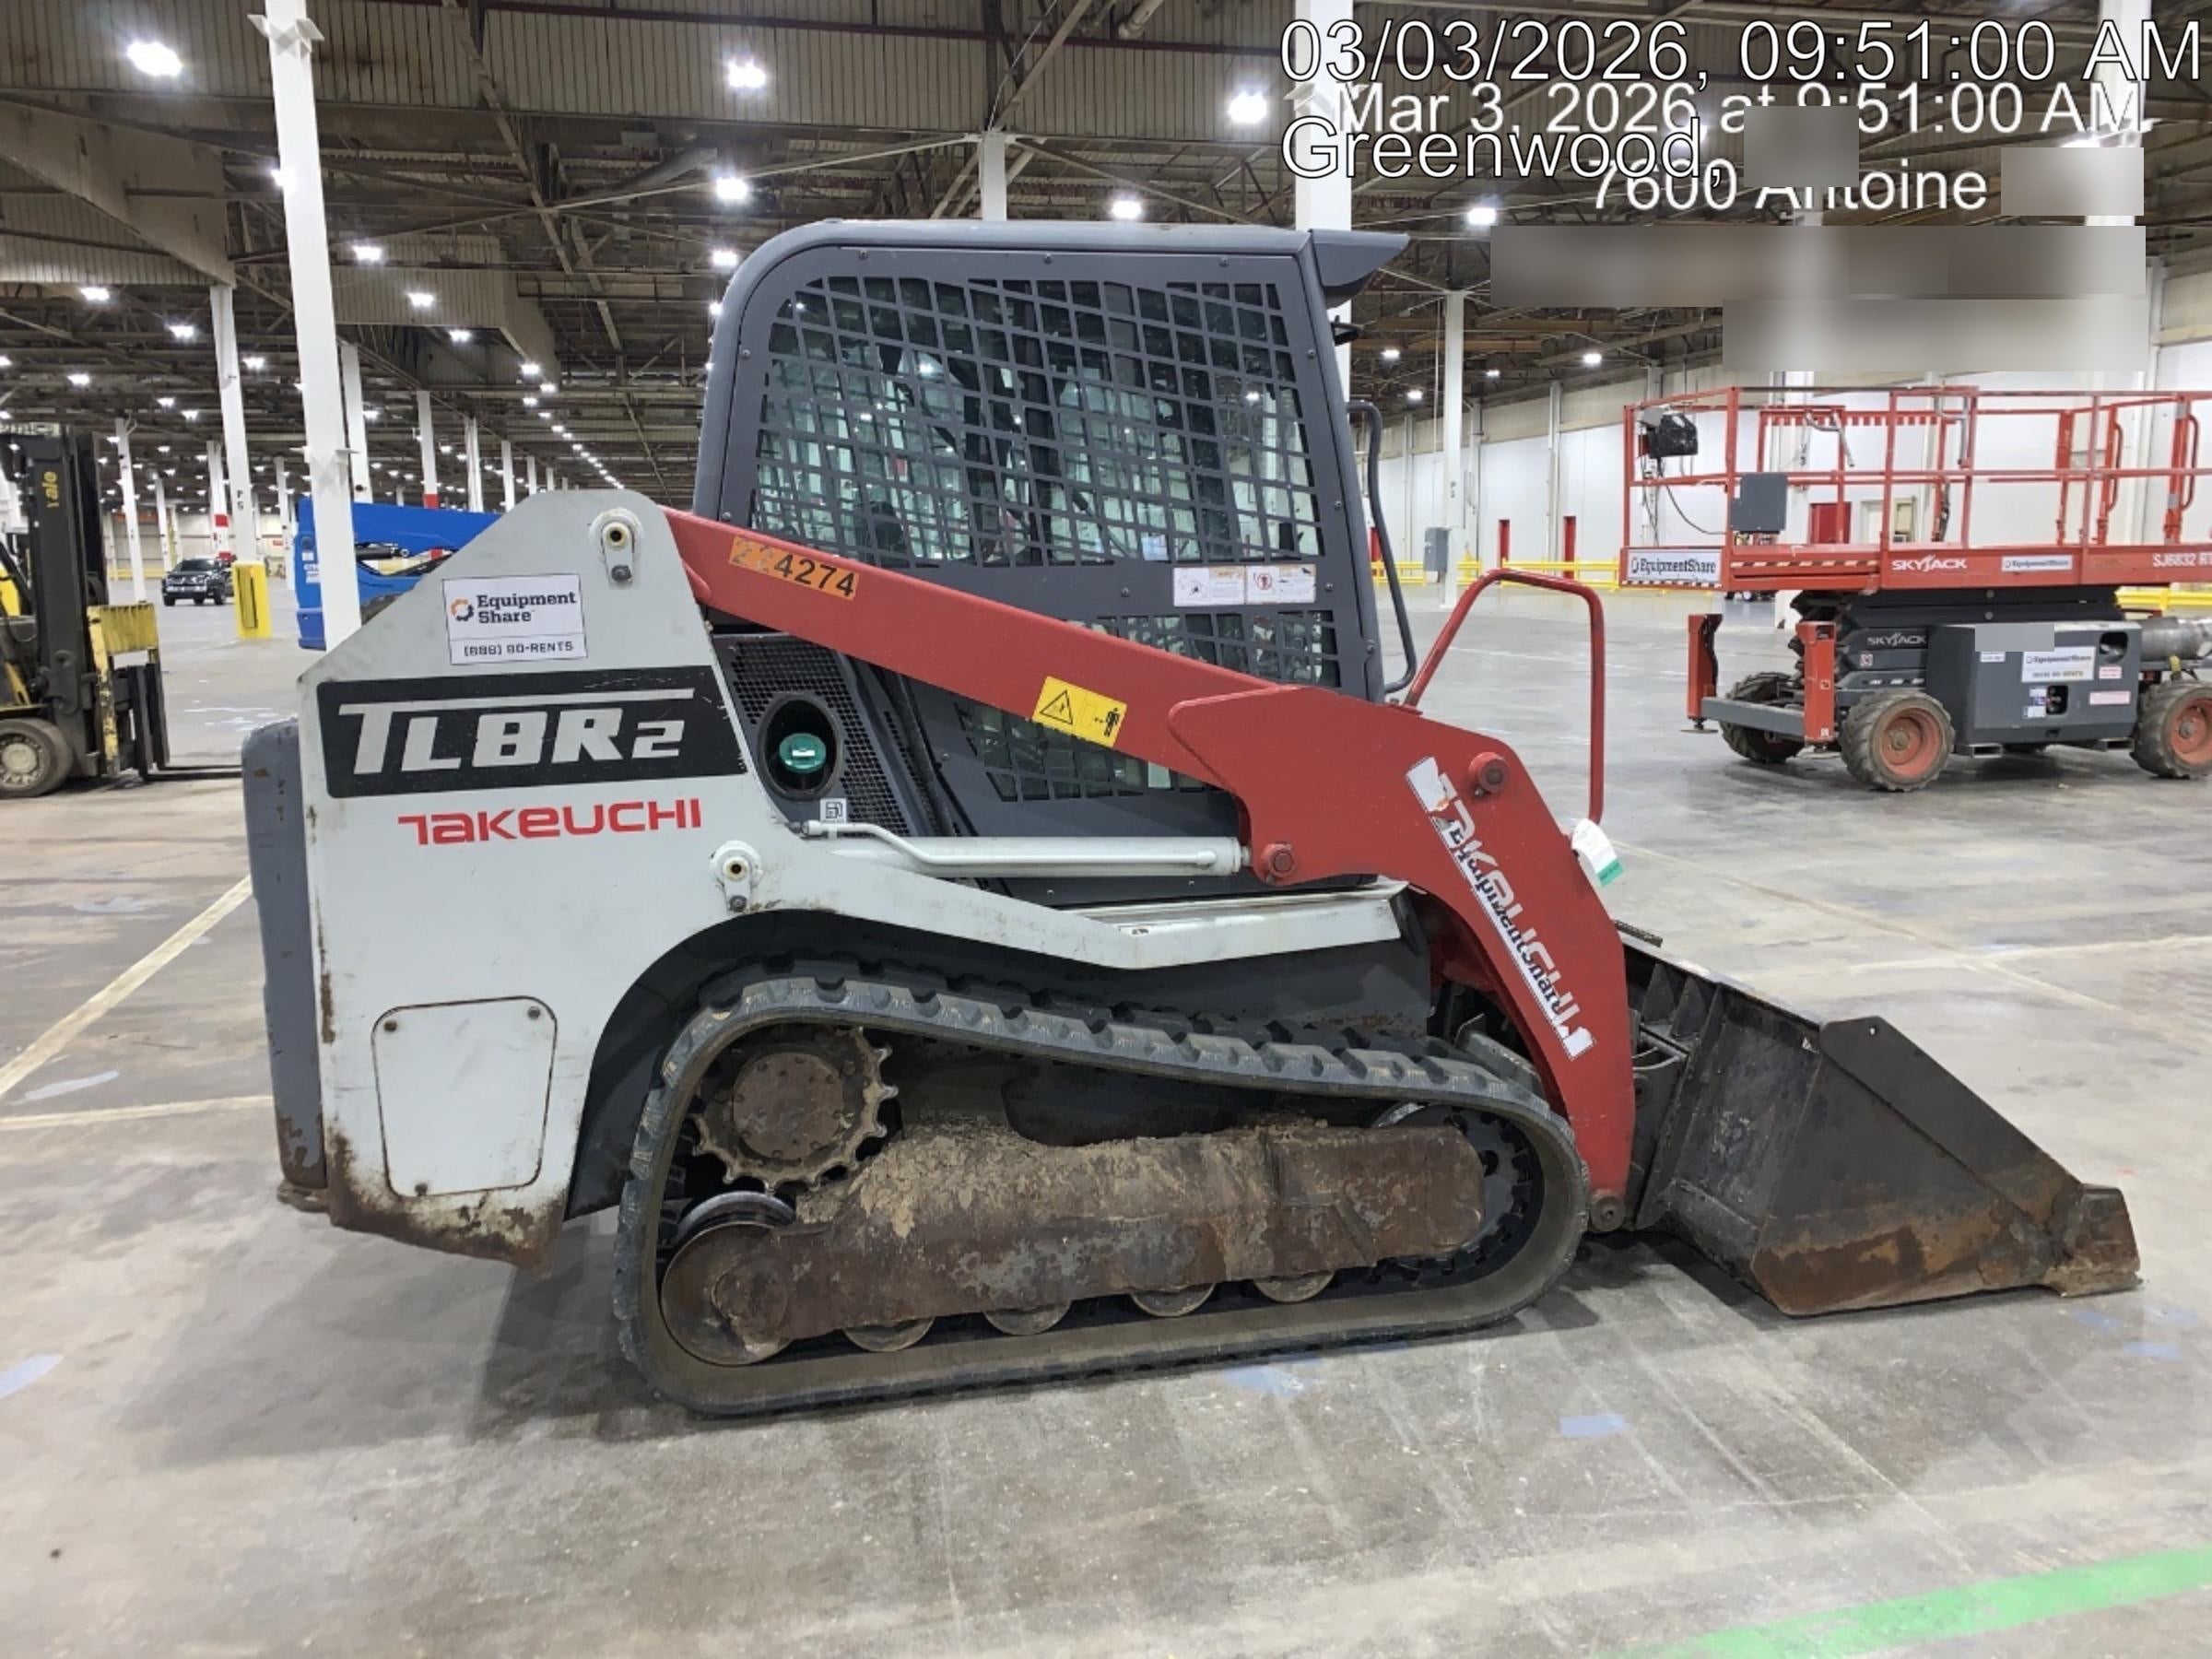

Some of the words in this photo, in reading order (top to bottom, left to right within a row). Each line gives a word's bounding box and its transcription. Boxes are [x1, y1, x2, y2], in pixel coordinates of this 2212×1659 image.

[1641, 558, 1717, 575] EquipmentShare
[1891, 554, 1968, 571] SKYJACK
[476, 591, 578, 610] Equipment
[478, 609, 533, 624] Share
[464, 644, 502, 657] (888)
[506, 641, 574, 655] 80-RENTS
[338, 688, 695, 776] TL8R2
[397, 798, 701, 846] TAKEUCHI
